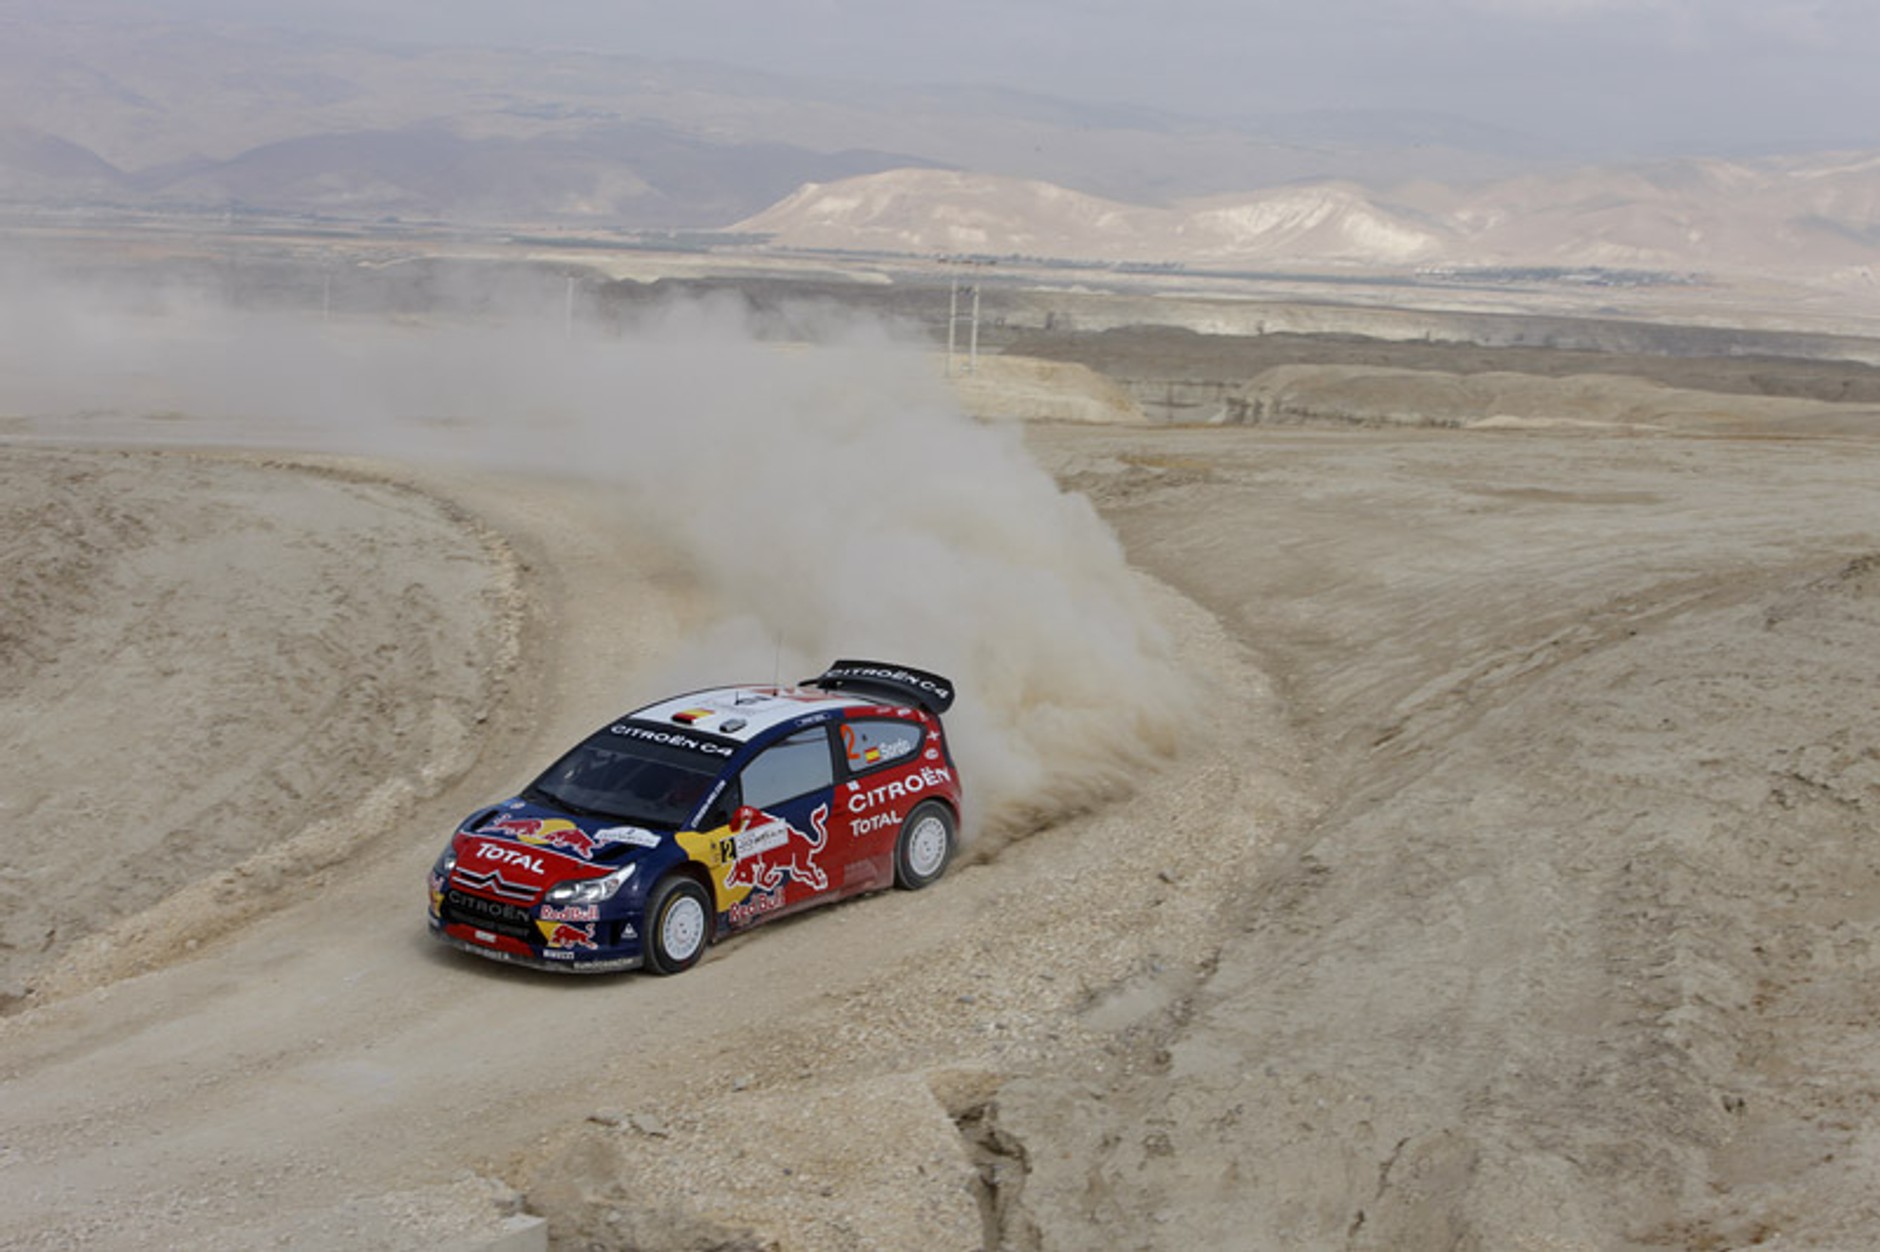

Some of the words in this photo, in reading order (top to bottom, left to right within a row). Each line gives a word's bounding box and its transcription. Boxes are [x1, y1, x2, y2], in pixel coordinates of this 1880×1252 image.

[825, 669, 920, 684] CITROËN
[920, 682, 949, 699] C4
[610, 724, 699, 749] CITROËN
[700, 742, 733, 757] C4
[840, 724, 861, 760] 2
[847, 766, 951, 813] CITROËN
[849, 810, 903, 837] TOTAL
[476, 842, 545, 874] TOTAL
[448, 890, 530, 923] CITROËN
[540, 904, 570, 920] Red
[572, 904, 599, 920] Bull
